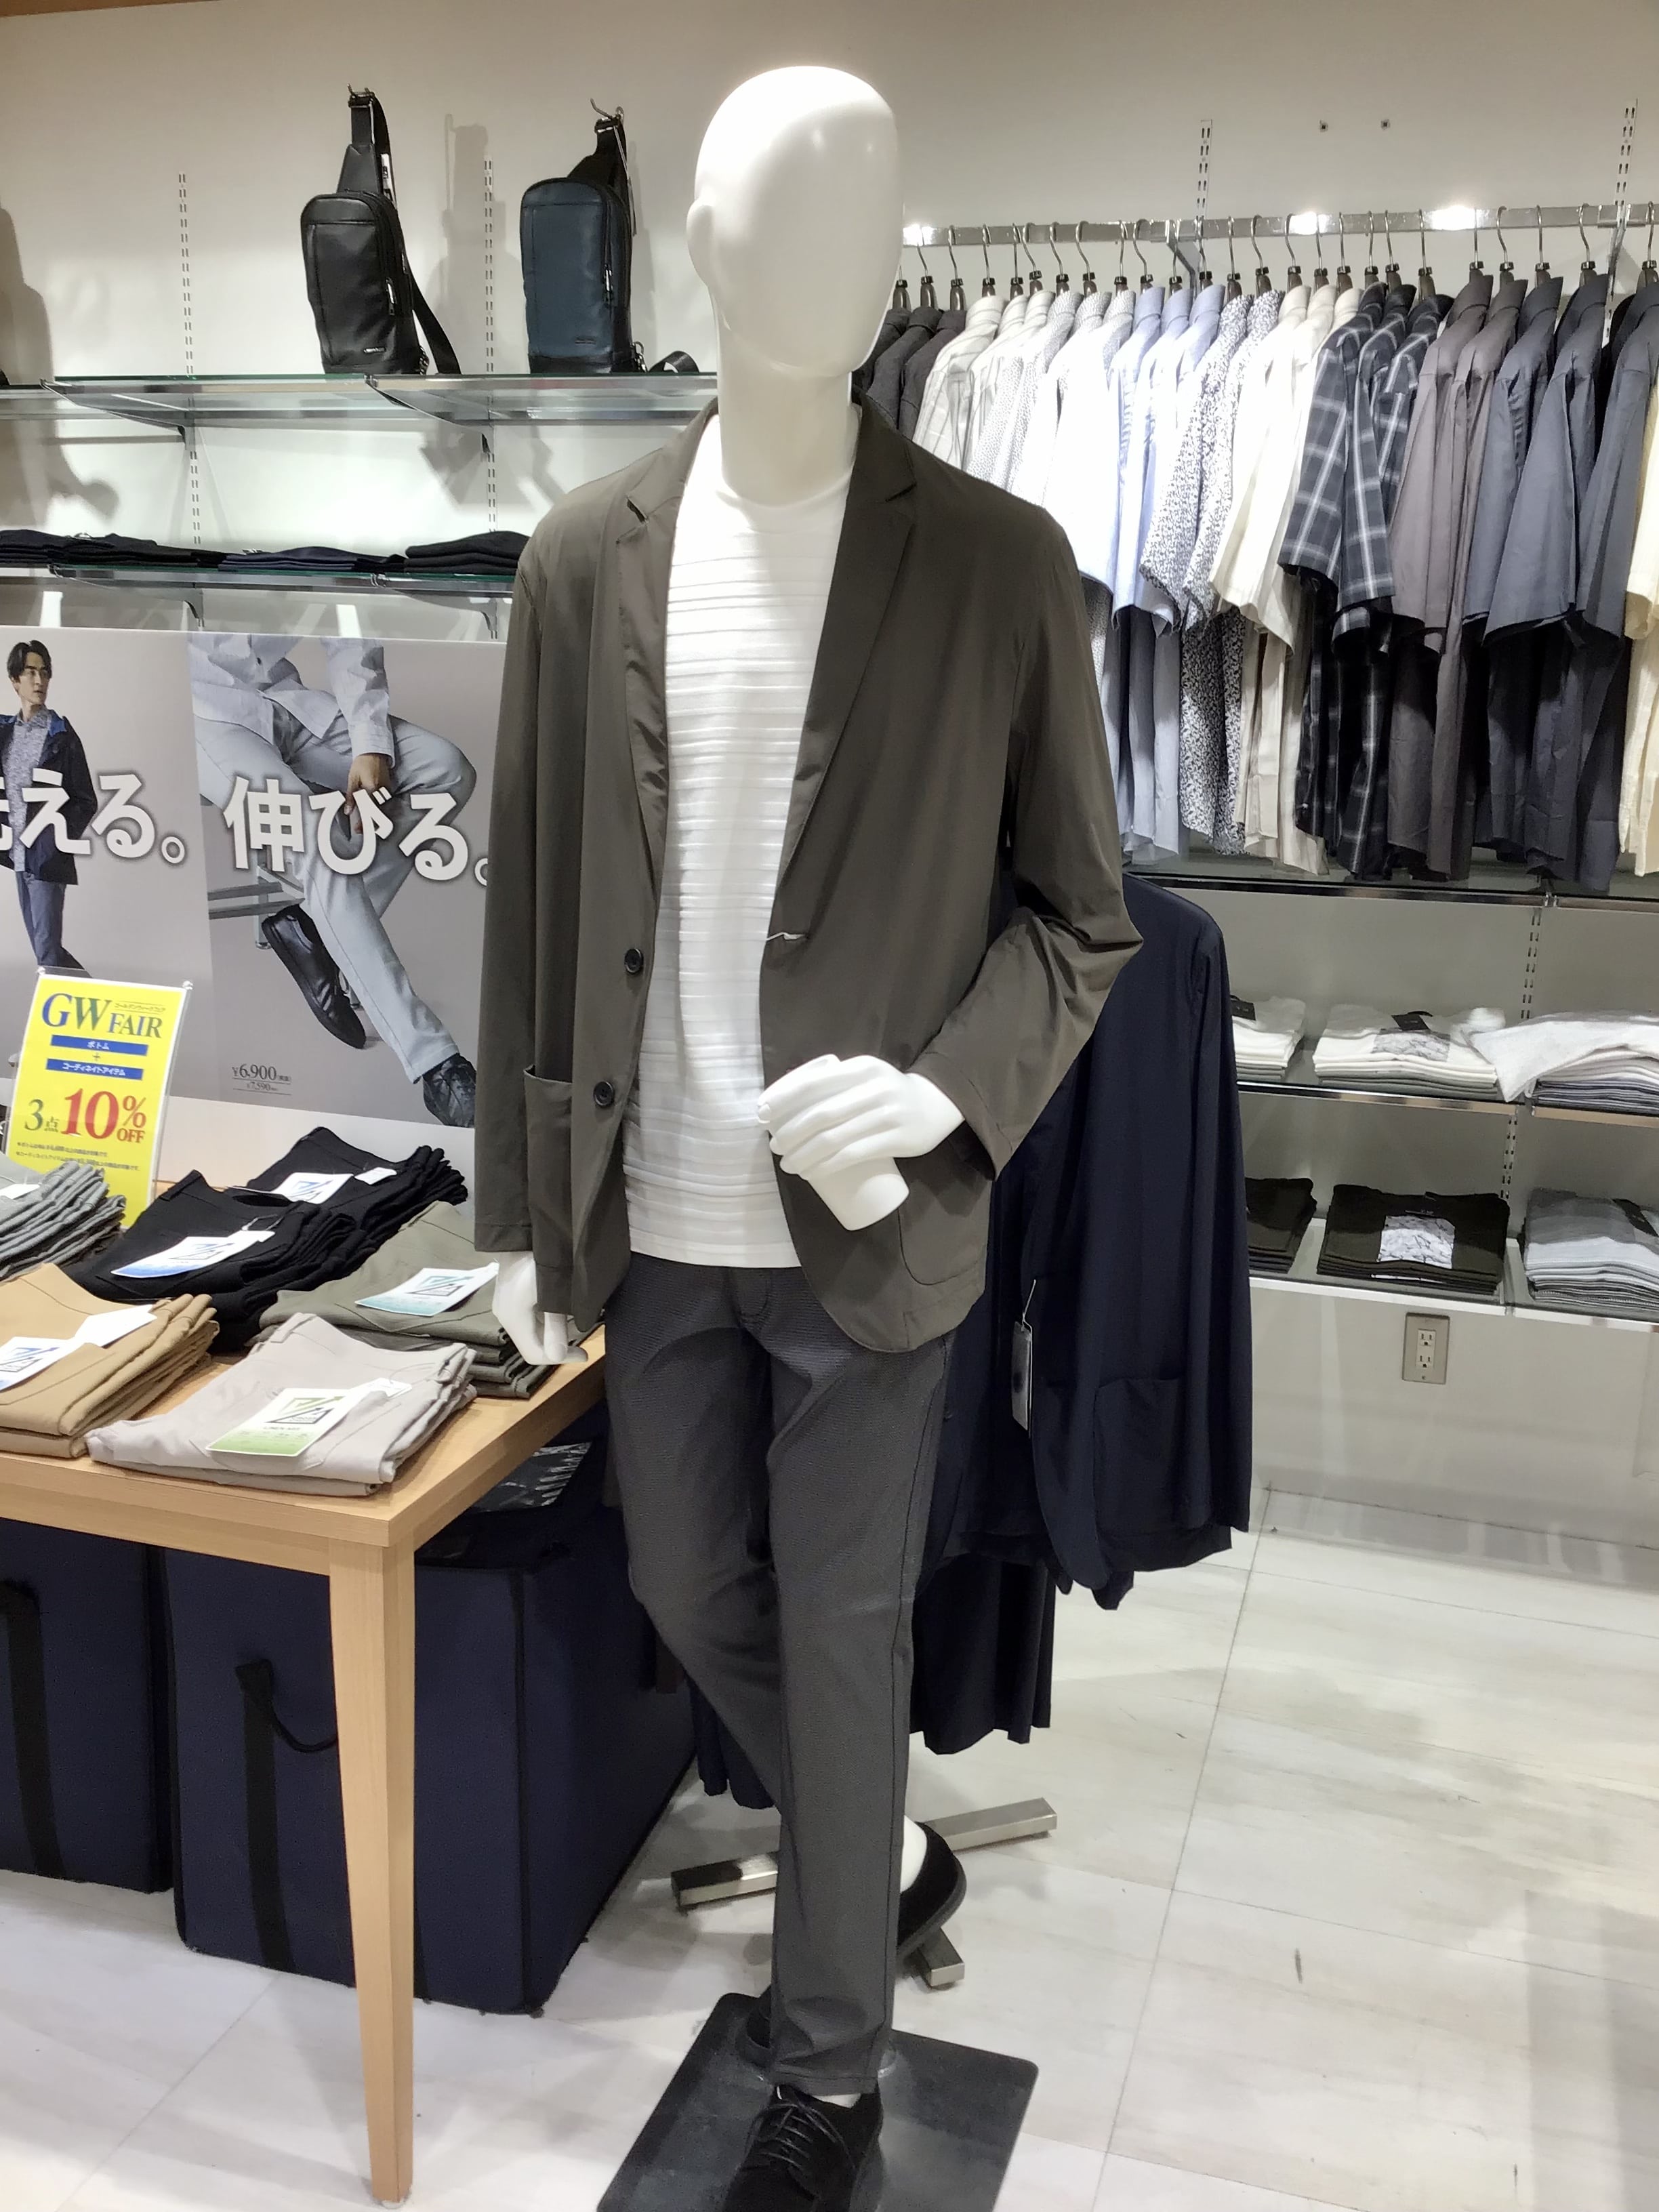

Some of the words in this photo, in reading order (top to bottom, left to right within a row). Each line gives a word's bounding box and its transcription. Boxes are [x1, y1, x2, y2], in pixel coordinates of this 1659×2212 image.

[0, 768, 185, 863] える。
[223, 776, 488, 886] 伸びる。
[42, 993, 112, 1031] GW
[108, 1012, 163, 1038] FAIR
[87, 1041, 110, 1050] ボトム
[117, 1128, 146, 1143] OFF
